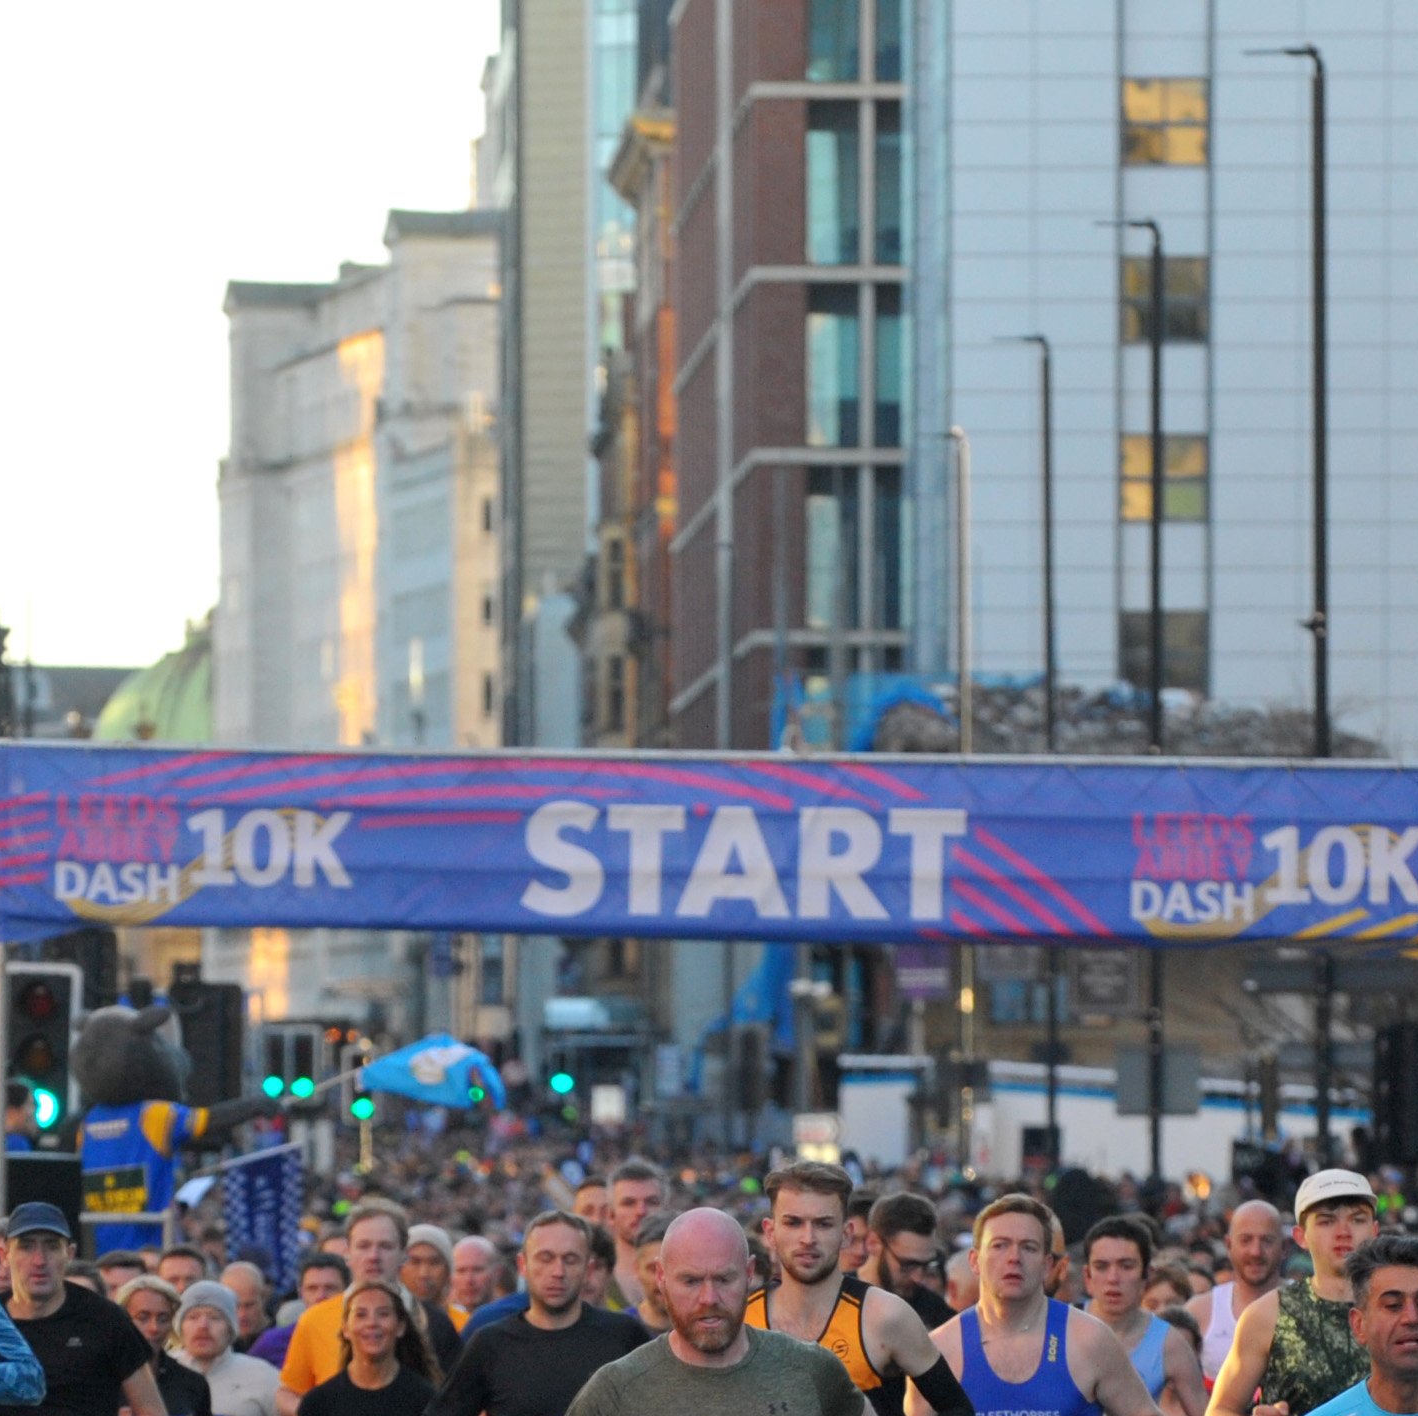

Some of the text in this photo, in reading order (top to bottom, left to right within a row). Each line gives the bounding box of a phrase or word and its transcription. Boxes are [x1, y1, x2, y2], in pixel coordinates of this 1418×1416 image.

[56, 796, 179, 828] LEEDS
[1132, 813, 1254, 847] LEEDS
[57, 830, 178, 863] ABBEY
[186, 808, 353, 888] 10K
[519, 799, 967, 919] START
[1133, 849, 1254, 880] ABBEY
[54, 860, 181, 905] DASH
[1131, 880, 1255, 922] DASH
